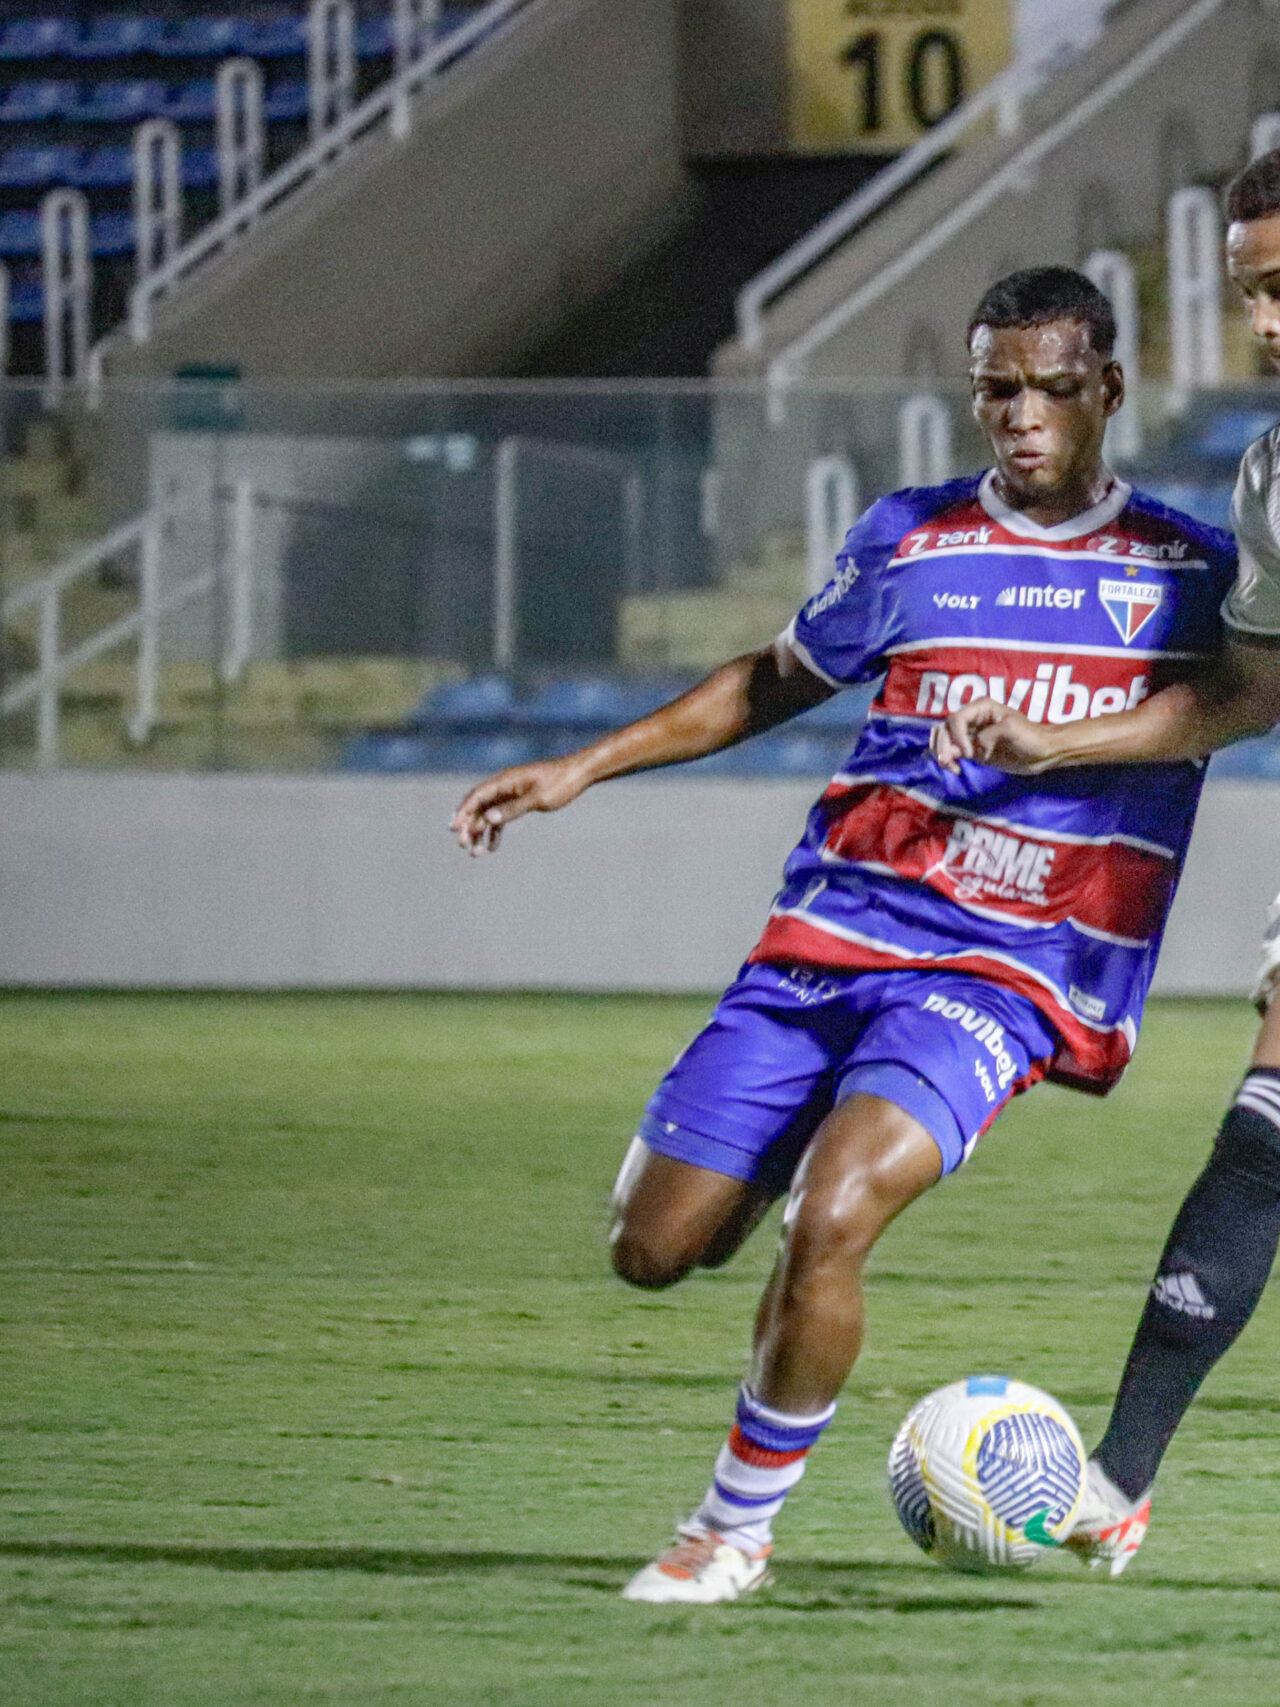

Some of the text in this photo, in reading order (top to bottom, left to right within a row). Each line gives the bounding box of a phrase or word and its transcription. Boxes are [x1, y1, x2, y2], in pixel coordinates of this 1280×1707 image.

[838, 29, 965, 131] 10
[1018, 584, 1086, 609] inter
[1101, 583, 1159, 599] FORTALEZA
[916, 662, 1149, 725] novibet
[943, 820, 1056, 892] PRIME
[920, 993, 1018, 1090] novibet
